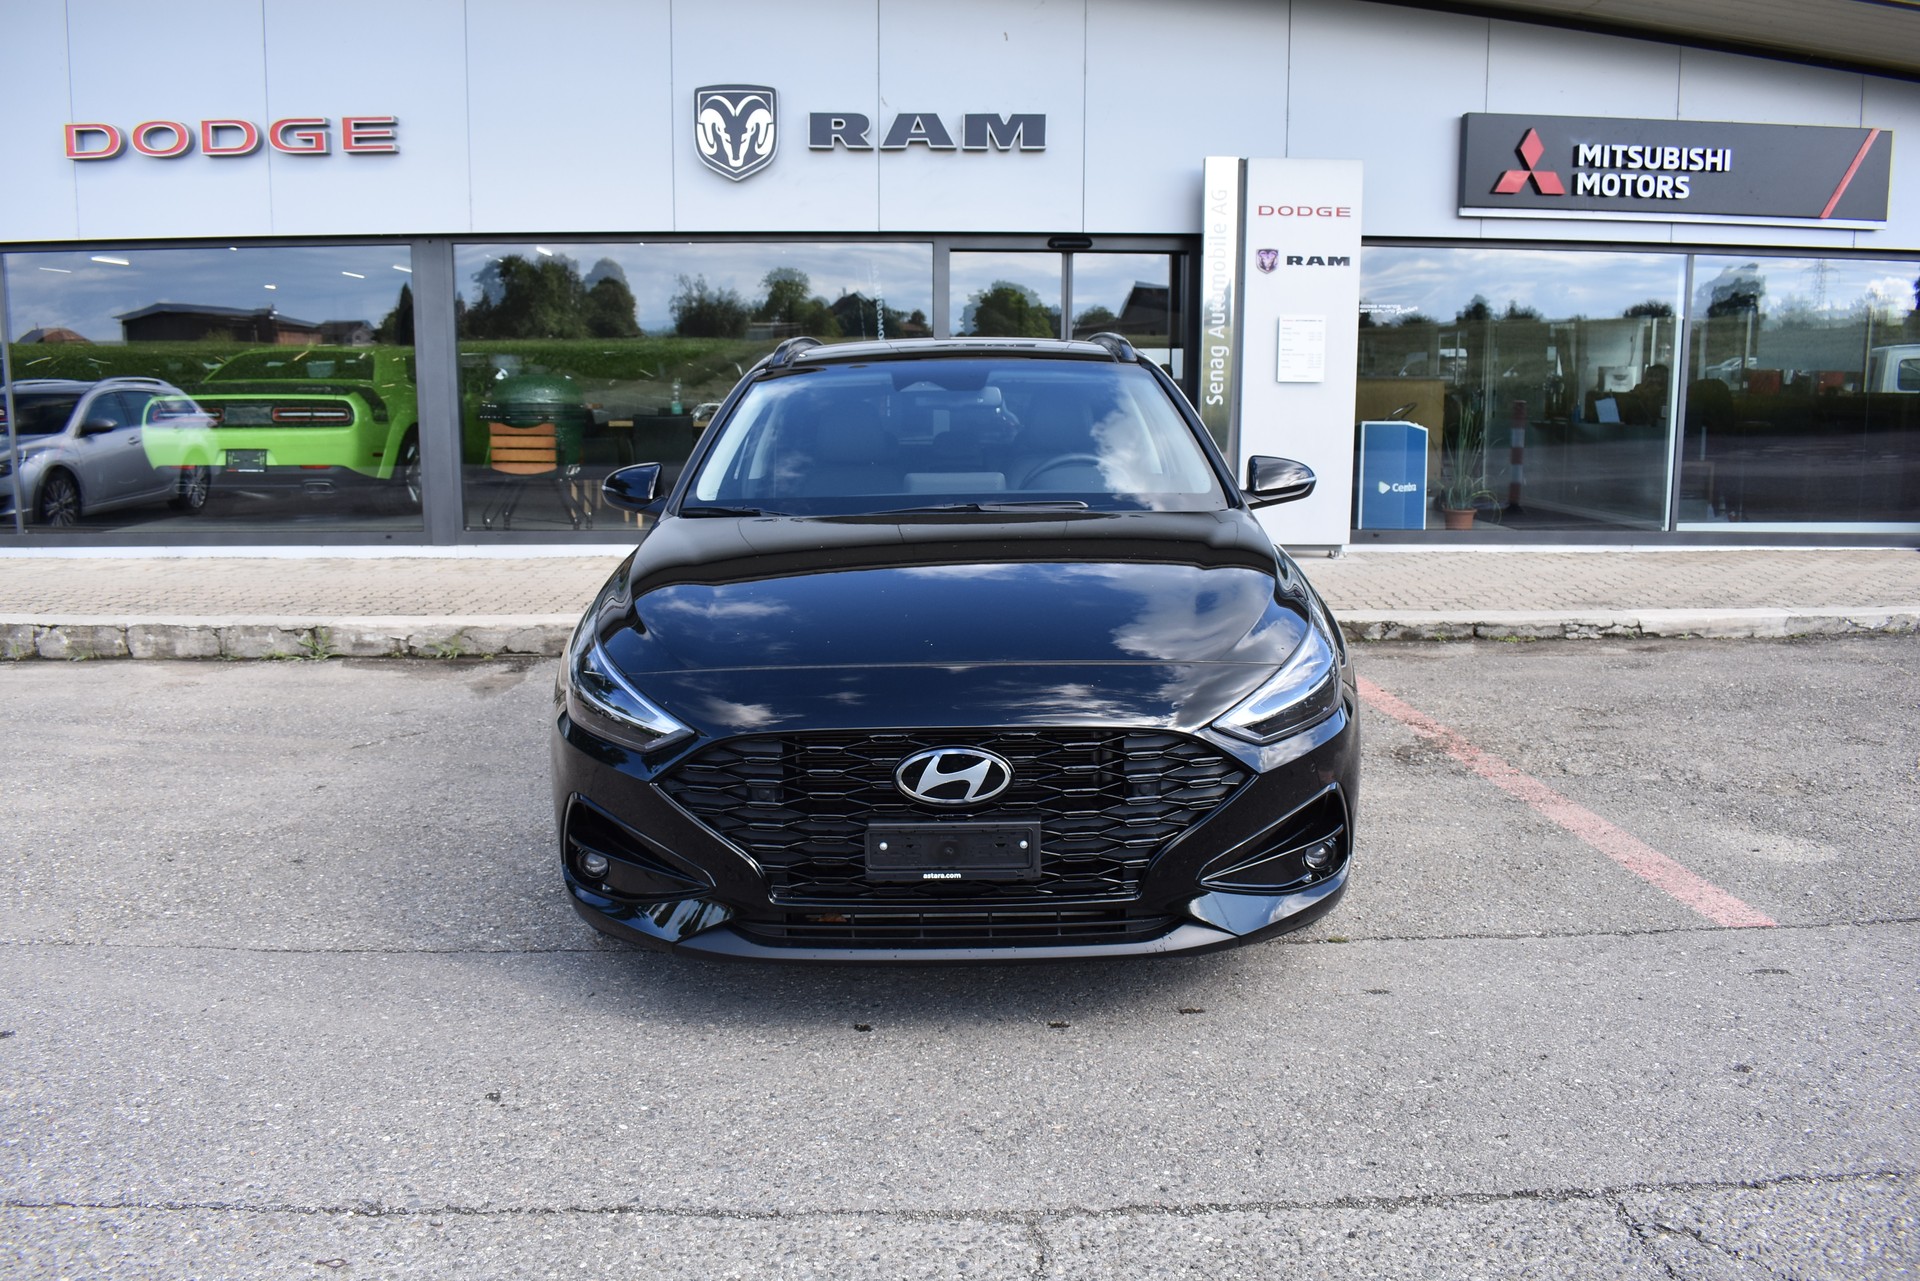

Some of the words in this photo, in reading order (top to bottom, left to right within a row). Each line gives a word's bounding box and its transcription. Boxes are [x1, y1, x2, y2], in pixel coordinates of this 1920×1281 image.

[64, 116, 399, 160] DODGE
[808, 112, 1047, 150] RAM
[1577, 144, 1731, 172] MITSUBISHI
[1576, 172, 1690, 199] MOTORS
[1211, 189, 1228, 216] AG
[1258, 205, 1351, 218] DODGE
[1286, 255, 1350, 266] RAM
[1208, 223, 1226, 339] Automobile
[1206, 345, 1229, 405] Senag
